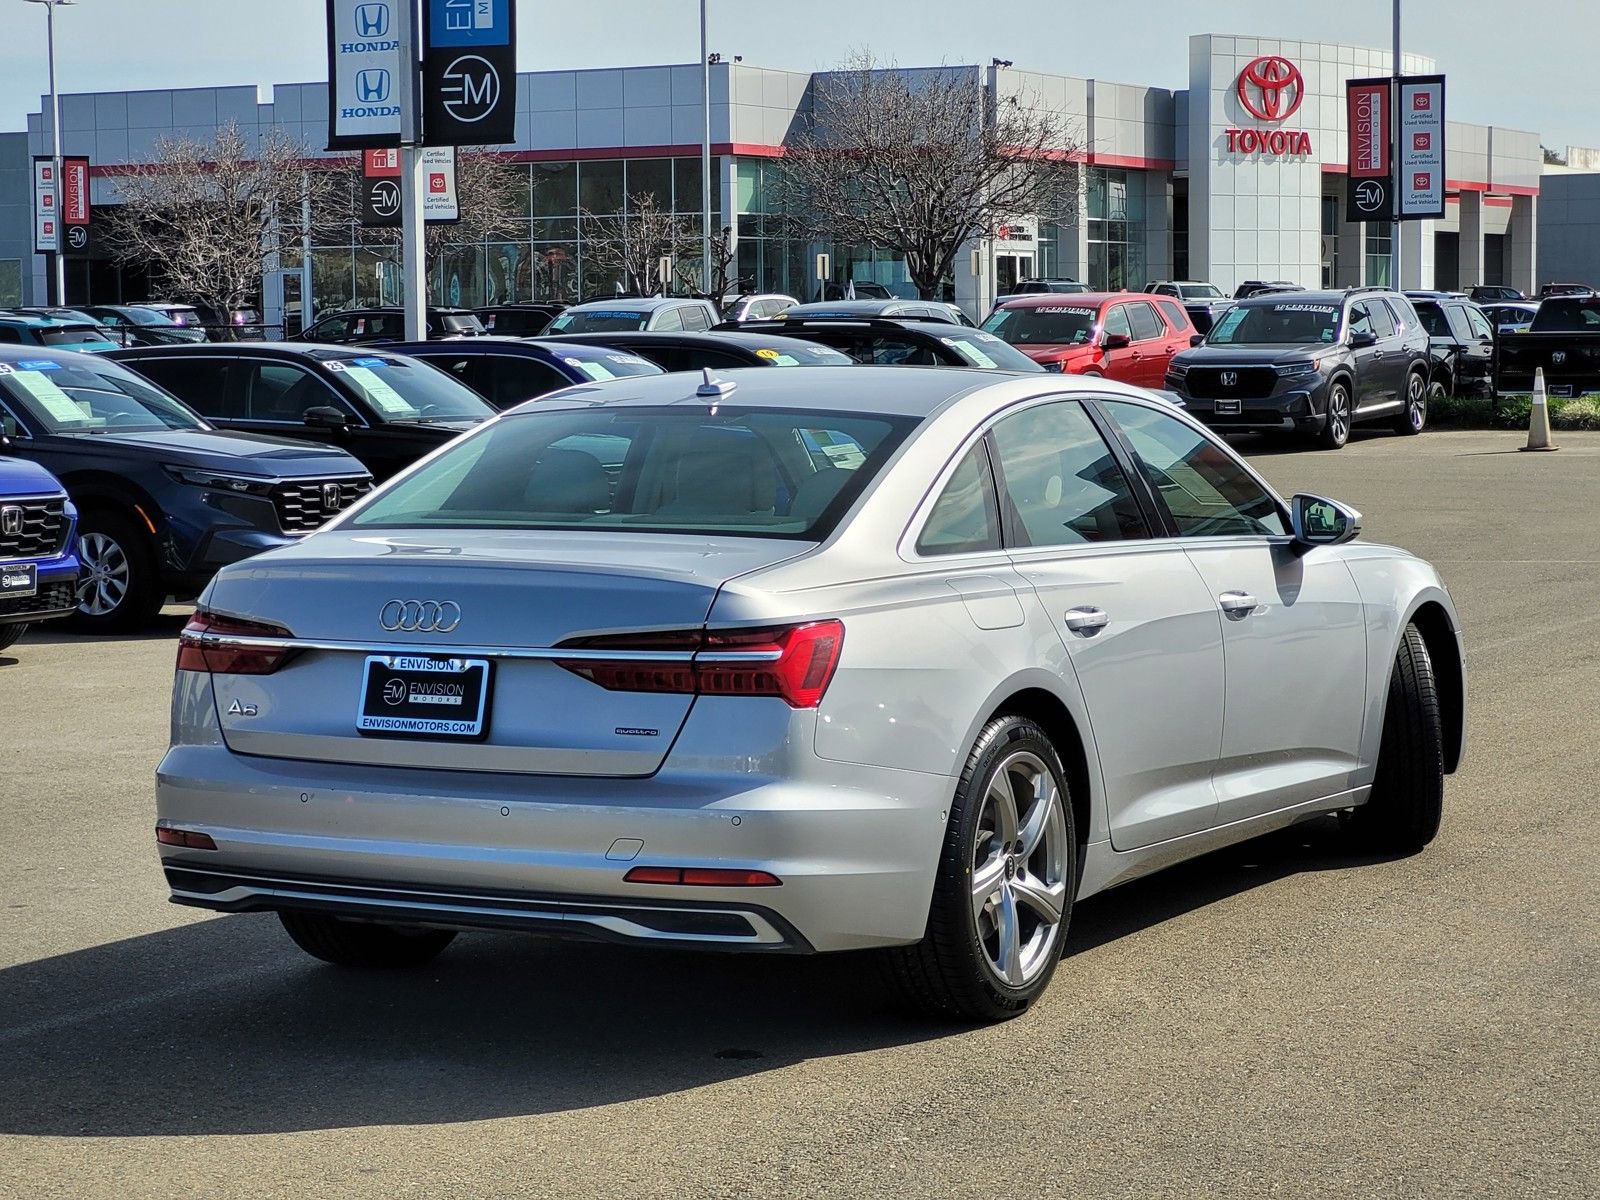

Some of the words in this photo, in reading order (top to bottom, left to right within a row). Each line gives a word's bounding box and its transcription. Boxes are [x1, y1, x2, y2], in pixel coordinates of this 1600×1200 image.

[340, 40, 399, 54] HONDA
[341, 106, 400, 119] HONDA
[1358, 93, 1371, 170] ENVISION
[1225, 128, 1312, 156] TOYOTA
[69, 165, 80, 219] ENVISION
[400, 658, 454, 671] ENVISION
[409, 682, 464, 695] ENVISION
[228, 698, 258, 716] A6
[363, 718, 475, 732] ENVISIONMOTORS.COM
